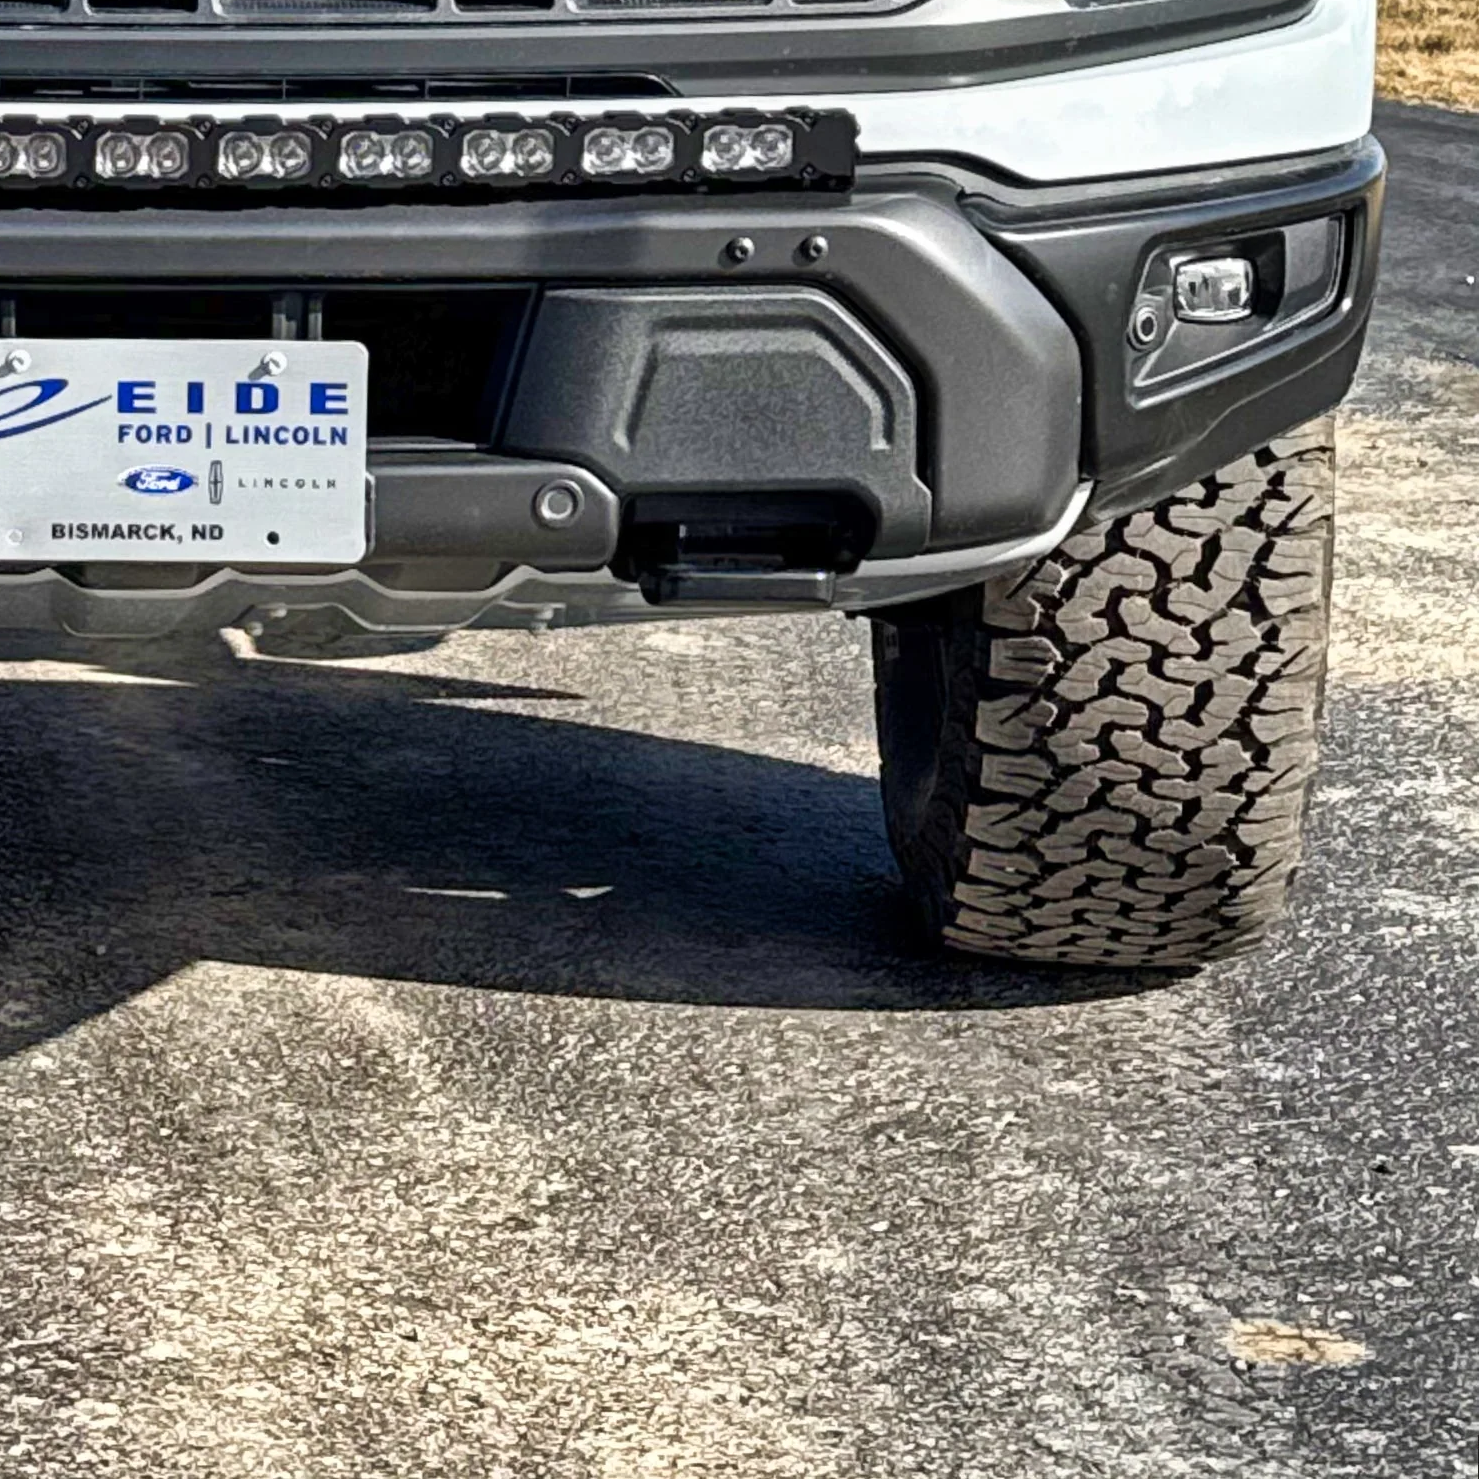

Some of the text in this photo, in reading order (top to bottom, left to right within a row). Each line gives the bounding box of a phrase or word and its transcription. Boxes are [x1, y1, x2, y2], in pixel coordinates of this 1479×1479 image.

[117, 381, 349, 415] EIDE
[117, 424, 348, 446] FORD LINCOLN
[135, 471, 182, 491] Ford
[237, 478, 337, 489] LINCOLN
[51, 523, 224, 544] BISMARCK, ND
